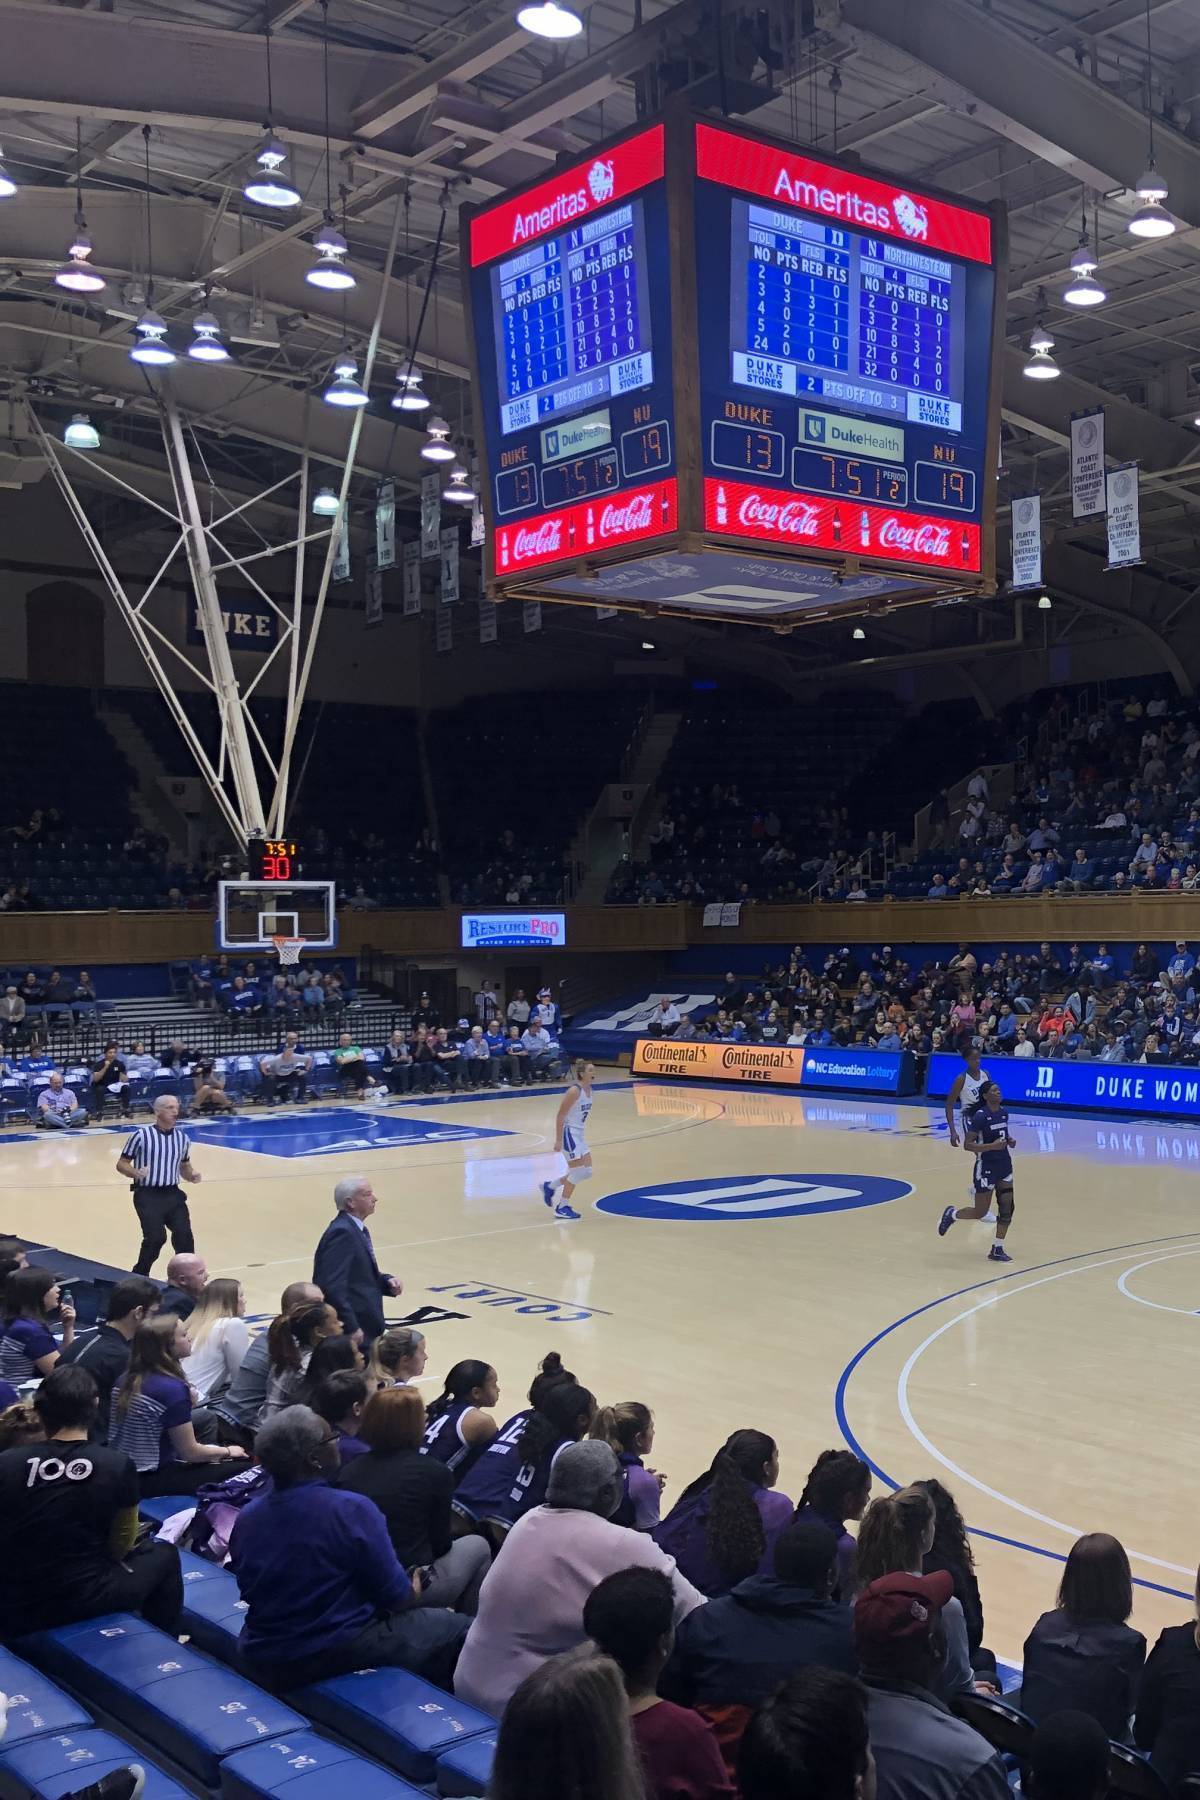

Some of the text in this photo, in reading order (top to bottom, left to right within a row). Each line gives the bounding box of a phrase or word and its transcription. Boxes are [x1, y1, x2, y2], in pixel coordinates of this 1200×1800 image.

[774, 168, 892, 228] Ameritas
[512, 188, 589, 244] Ameritas
[773, 213, 803, 233] DUKE
[572, 245, 633, 283] NO PTS REB FLS
[754, 246, 847, 283] NO PTS REB FLS
[884, 246, 951, 276] NORTHWESTERN
[505, 278, 561, 313] NO PTS REB FLS
[865, 277, 949, 311] NO PTS REB FLS
[754, 335, 768, 351] 24
[866, 328, 876, 343] 10
[866, 346, 876, 359] 21
[618, 357, 643, 375] DUKE
[746, 358, 783, 375] DUKE
[865, 362, 877, 377] 32
[619, 375, 643, 391] STORES
[746, 373, 783, 389] STORES
[807, 377, 815, 391] 2
[824, 382, 844, 398] PTS
[847, 387, 865, 403] OFF
[890, 395, 897, 409] 3
[509, 401, 530, 415] DUKE
[633, 404, 650, 424] NU
[725, 400, 773, 426] DUKE
[919, 397, 950, 413] DUKE
[510, 416, 531, 430] STORES
[919, 411, 950, 427] STORES
[642, 428, 661, 465] 19
[832, 427, 899, 452] DukeHealth
[501, 445, 528, 468] DUKE
[746, 434, 773, 470] 13
[933, 444, 955, 463] NU
[605, 465, 612, 484] 2
[822, 456, 881, 497] 7:51
[883, 471, 906, 482] PERIOD
[514, 470, 531, 503] 13
[889, 481, 899, 499] 2
[942, 472, 964, 503] 19
[266, 843, 295, 856] 7:51
[264, 858, 289, 879] 30
[642, 1042, 700, 1064] Continental
[722, 1046, 785, 1069] Continental
[657, 1063, 687, 1074] TIRE
[740, 1069, 772, 1080] TIRE
[815, 1062, 898, 1080] NC Education Lottery
[1096, 1076, 1144, 1099] DUKE
[426, 1283, 592, 1321] COURT
[26, 1456, 93, 1488] 100
